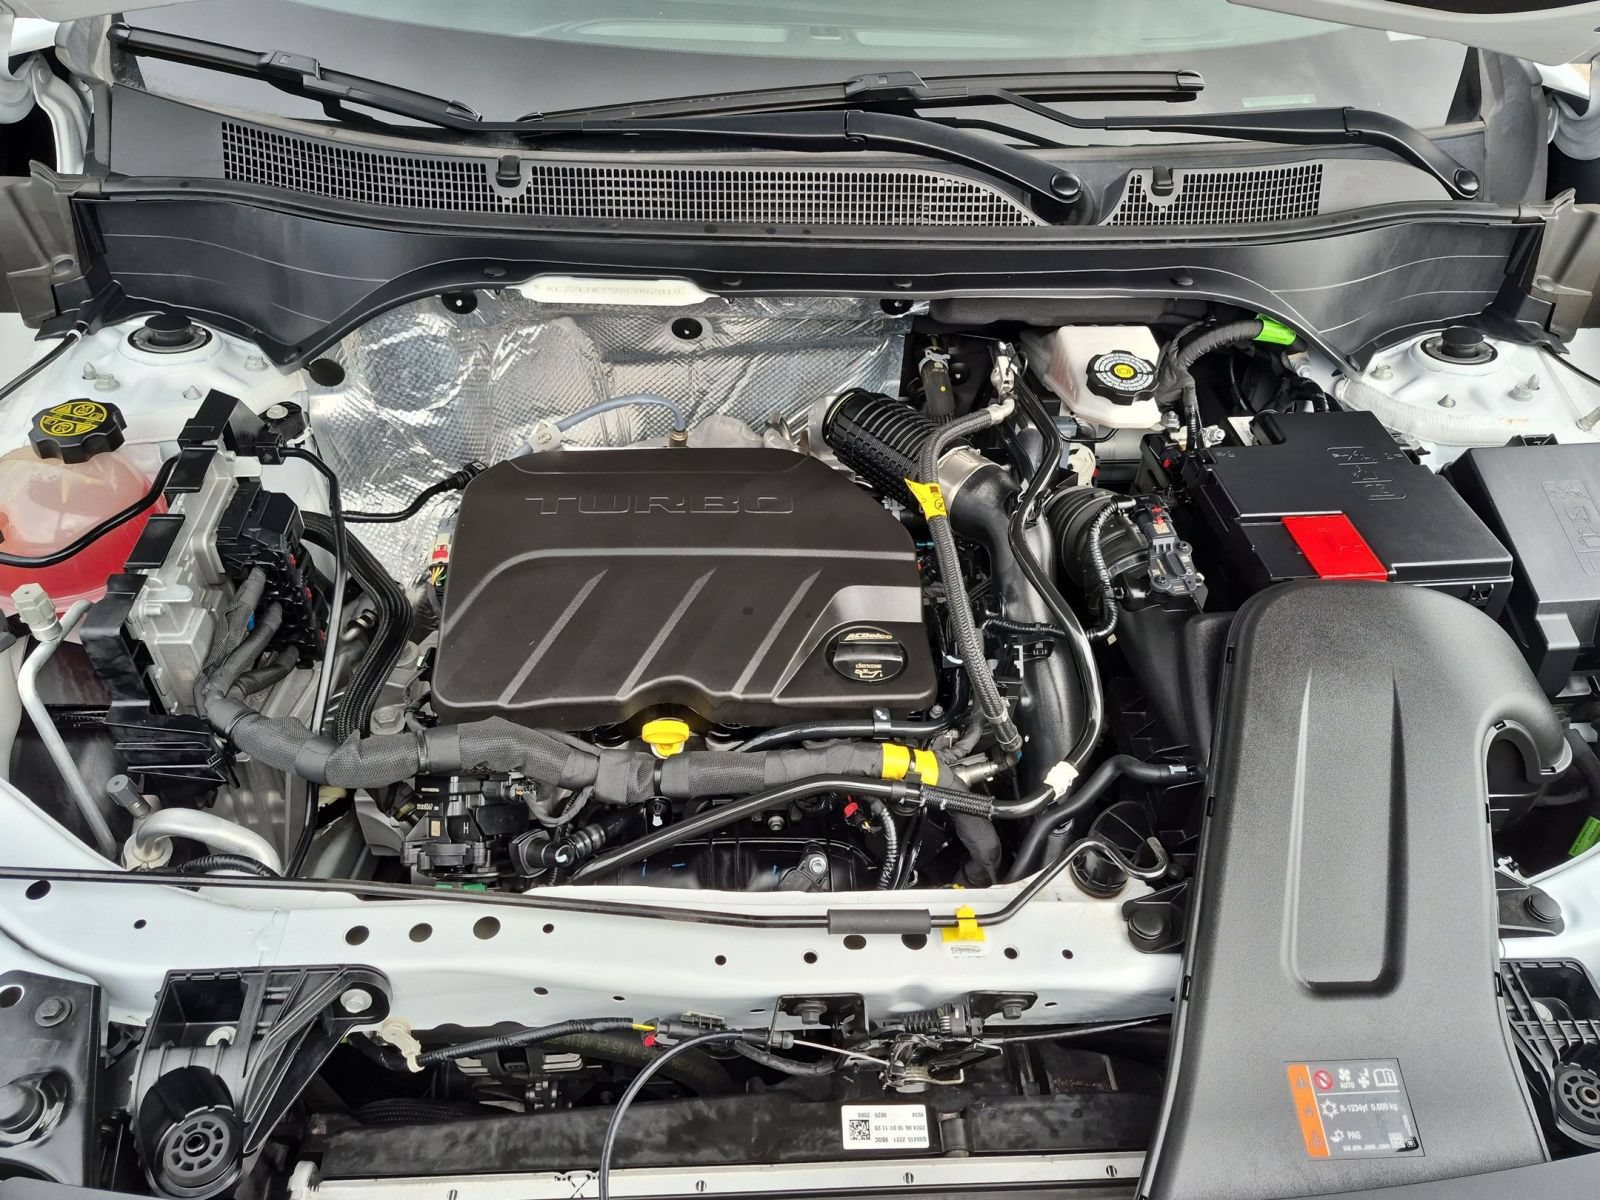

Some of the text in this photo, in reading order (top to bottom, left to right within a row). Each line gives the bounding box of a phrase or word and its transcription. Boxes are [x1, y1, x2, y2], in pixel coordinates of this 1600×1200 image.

[525, 495, 793, 515] TURBO
[1340, 1103, 1368, 1113] R-1234yf
[1347, 1130, 1361, 1140] PAG
